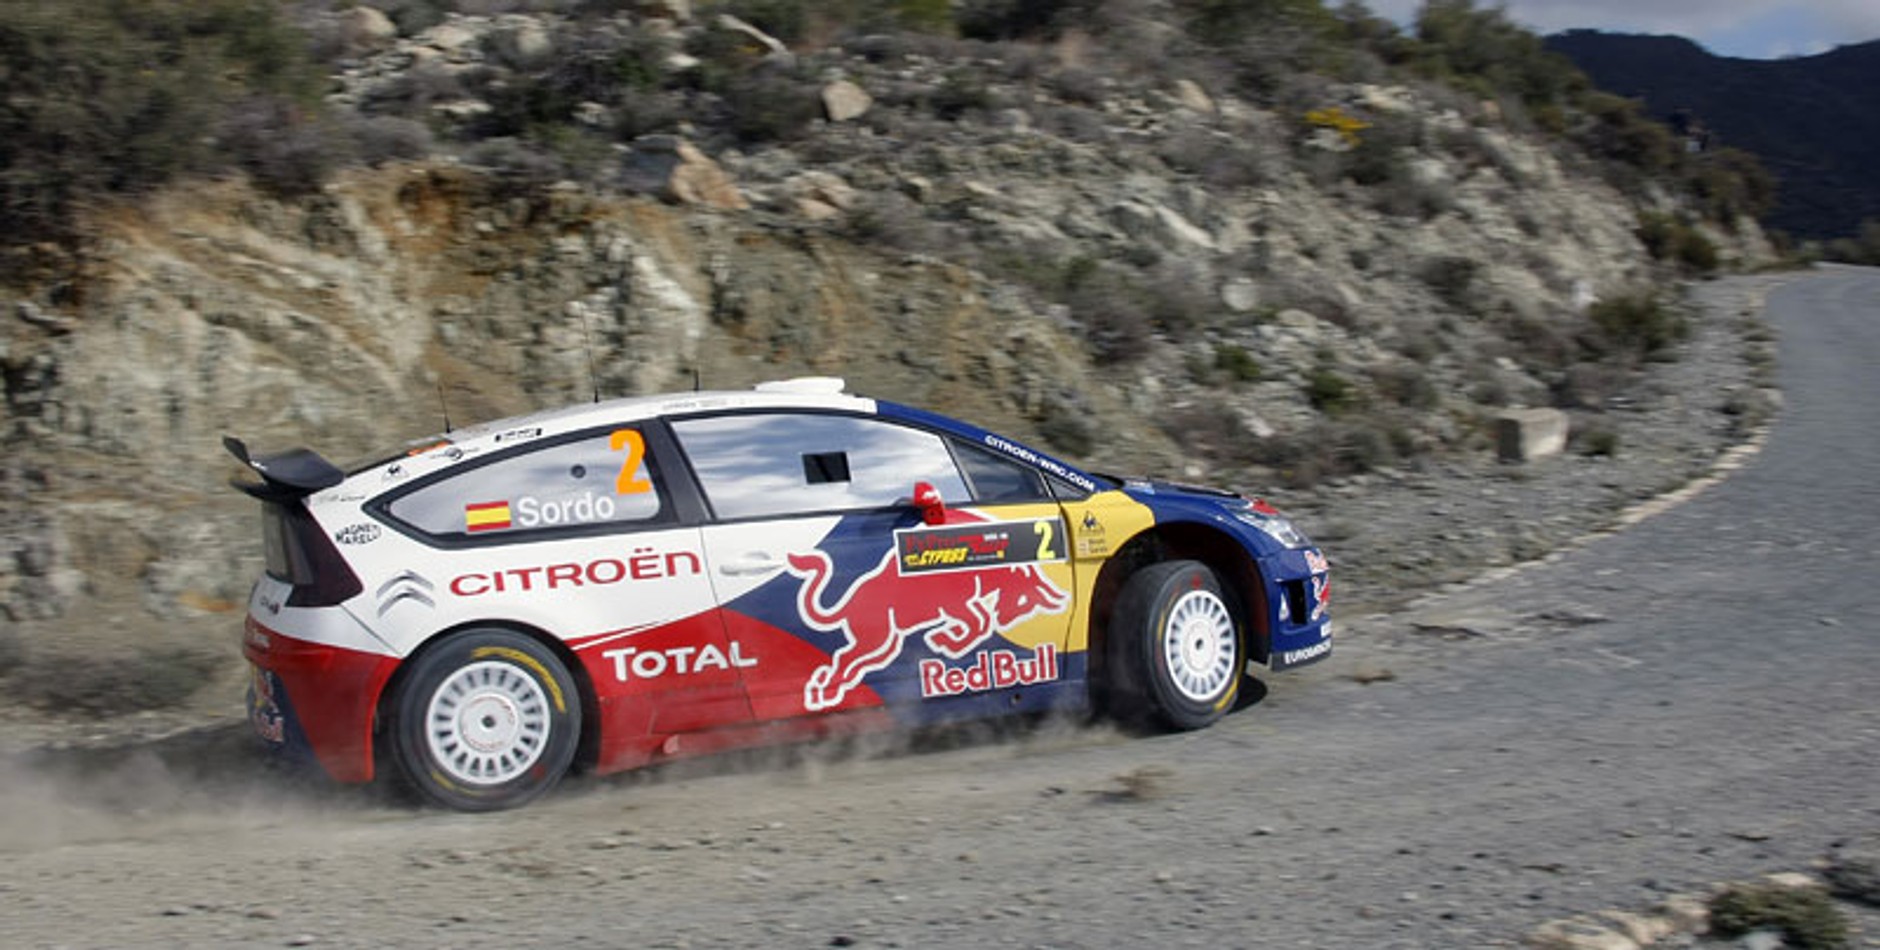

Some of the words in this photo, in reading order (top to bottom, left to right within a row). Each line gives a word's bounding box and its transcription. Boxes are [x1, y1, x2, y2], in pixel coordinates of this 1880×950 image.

[610, 429, 650, 495] 2
[517, 491, 615, 526] Sordo
[1033, 521, 1055, 560] 2
[920, 650, 991, 697] Red
[992, 643, 1058, 688] Bull
